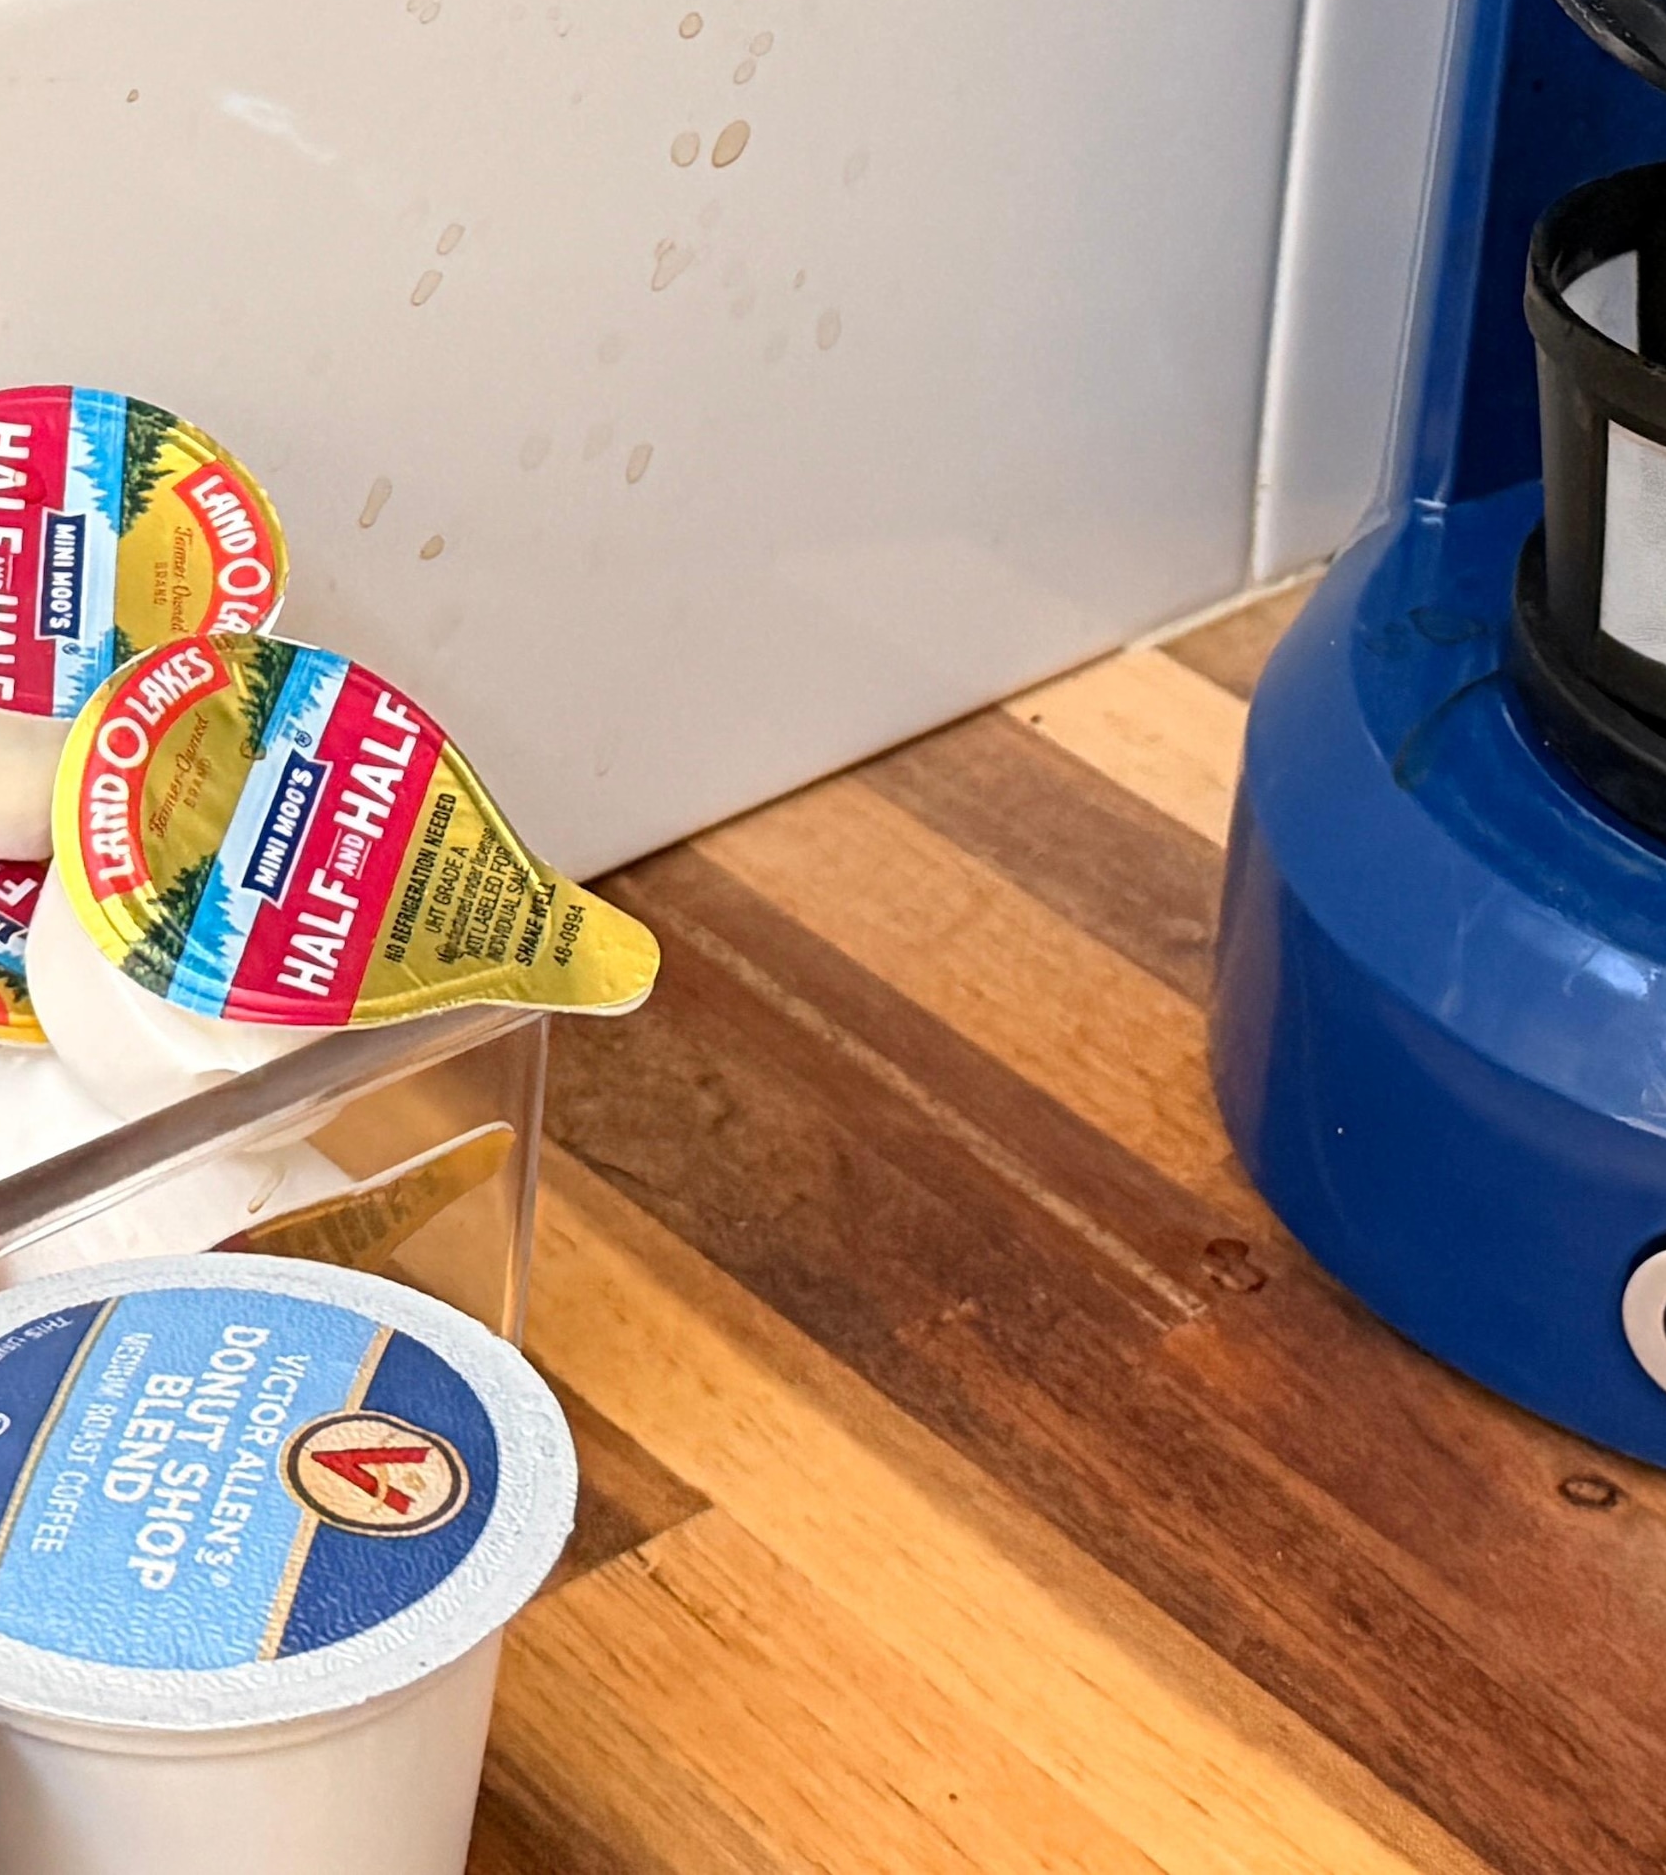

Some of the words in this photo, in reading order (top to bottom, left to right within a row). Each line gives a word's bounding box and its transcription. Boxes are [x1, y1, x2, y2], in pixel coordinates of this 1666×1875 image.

[53, 524, 76, 568] MINI
[190, 474, 257, 554] LAND
[49, 572, 74, 630] MOO'S
[125, 646, 215, 725] LAKES
[97, 716, 149, 769] O
[334, 690, 421, 839] HALF
[90, 773, 135, 880] LAND
[254, 837, 289, 888] MINI
[273, 767, 314, 838] MOO'S
[424, 792, 457, 851] NEEDED
[334, 833, 365, 876] AND
[433, 856, 464, 905] GRADE
[392, 847, 438, 945] REFRIGERATION
[425, 905, 448, 934] UHT
[473, 875, 505, 933] LABELED
[277, 867, 360, 997] HALF
[384, 943, 406, 963] NO
[515, 916, 544, 967] SHAKE
[553, 904, 587, 967] 48-0994
[24, 1315, 75, 1340] THIS
[176, 1325, 271, 1453] DONUT
[240, 1354, 312, 1447] VICTOR
[66, 1402, 118, 1466] ROAST
[102, 1374, 195, 1503] BLEND
[31, 1471, 90, 1553] COFFEE
[128, 1459, 211, 1591] SHOP
